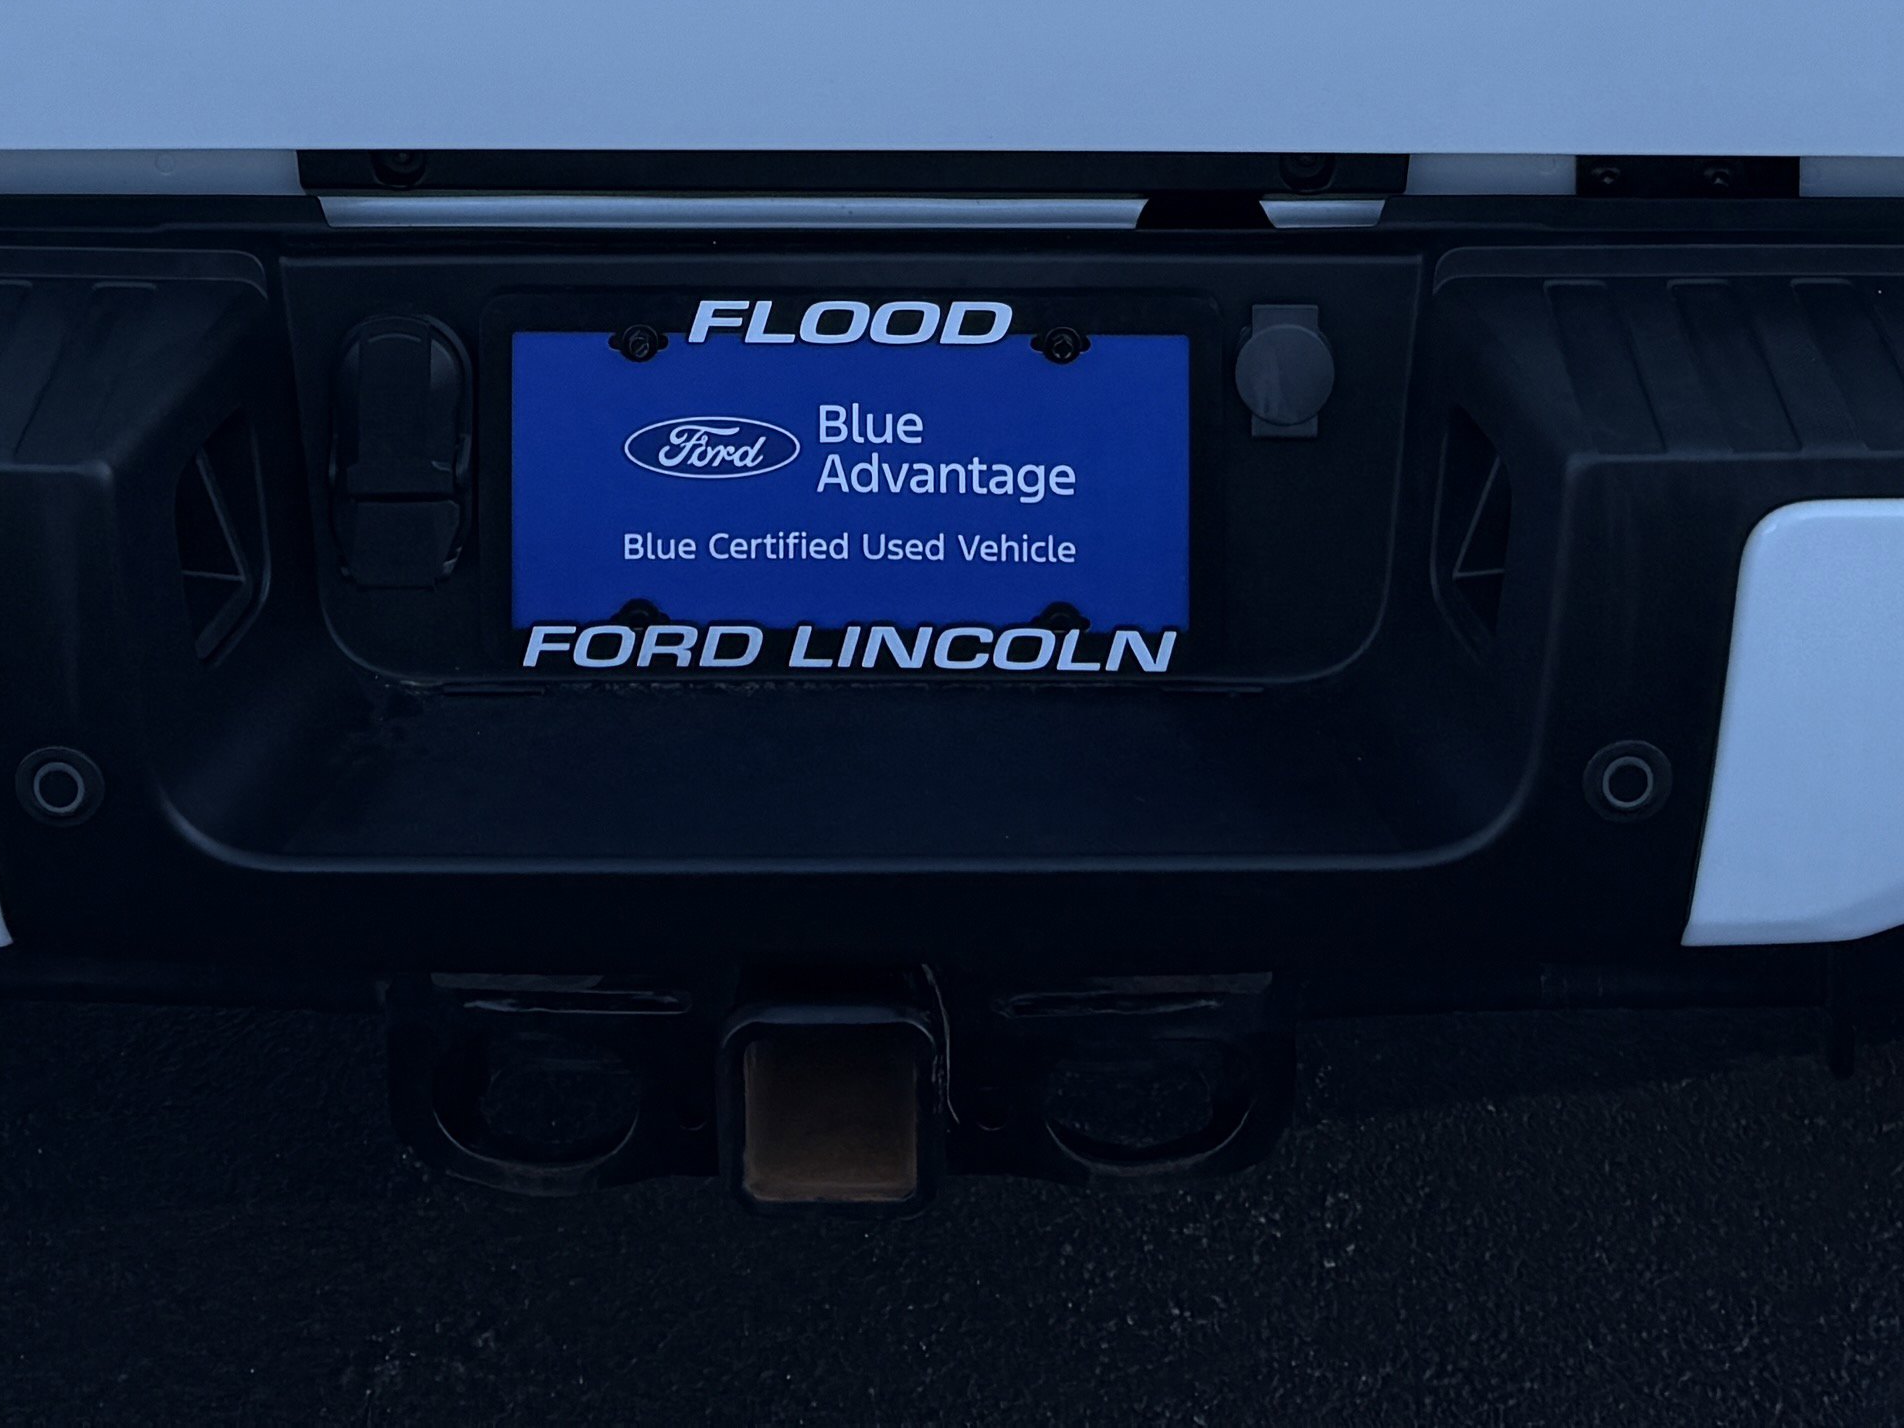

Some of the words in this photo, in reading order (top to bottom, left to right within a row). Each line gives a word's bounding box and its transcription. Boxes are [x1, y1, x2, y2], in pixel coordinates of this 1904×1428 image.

[687, 300, 1013, 345] FLOOD
[658, 424, 766, 470] Ford
[817, 404, 924, 445] Blue
[817, 453, 1077, 504] Advantage
[623, 532, 696, 560] Blue
[708, 531, 849, 561] Certified
[862, 533, 945, 562] Used
[957, 534, 1077, 564] Vehicle
[522, 625, 764, 669] FORD
[788, 625, 1178, 673] LINCOLN
